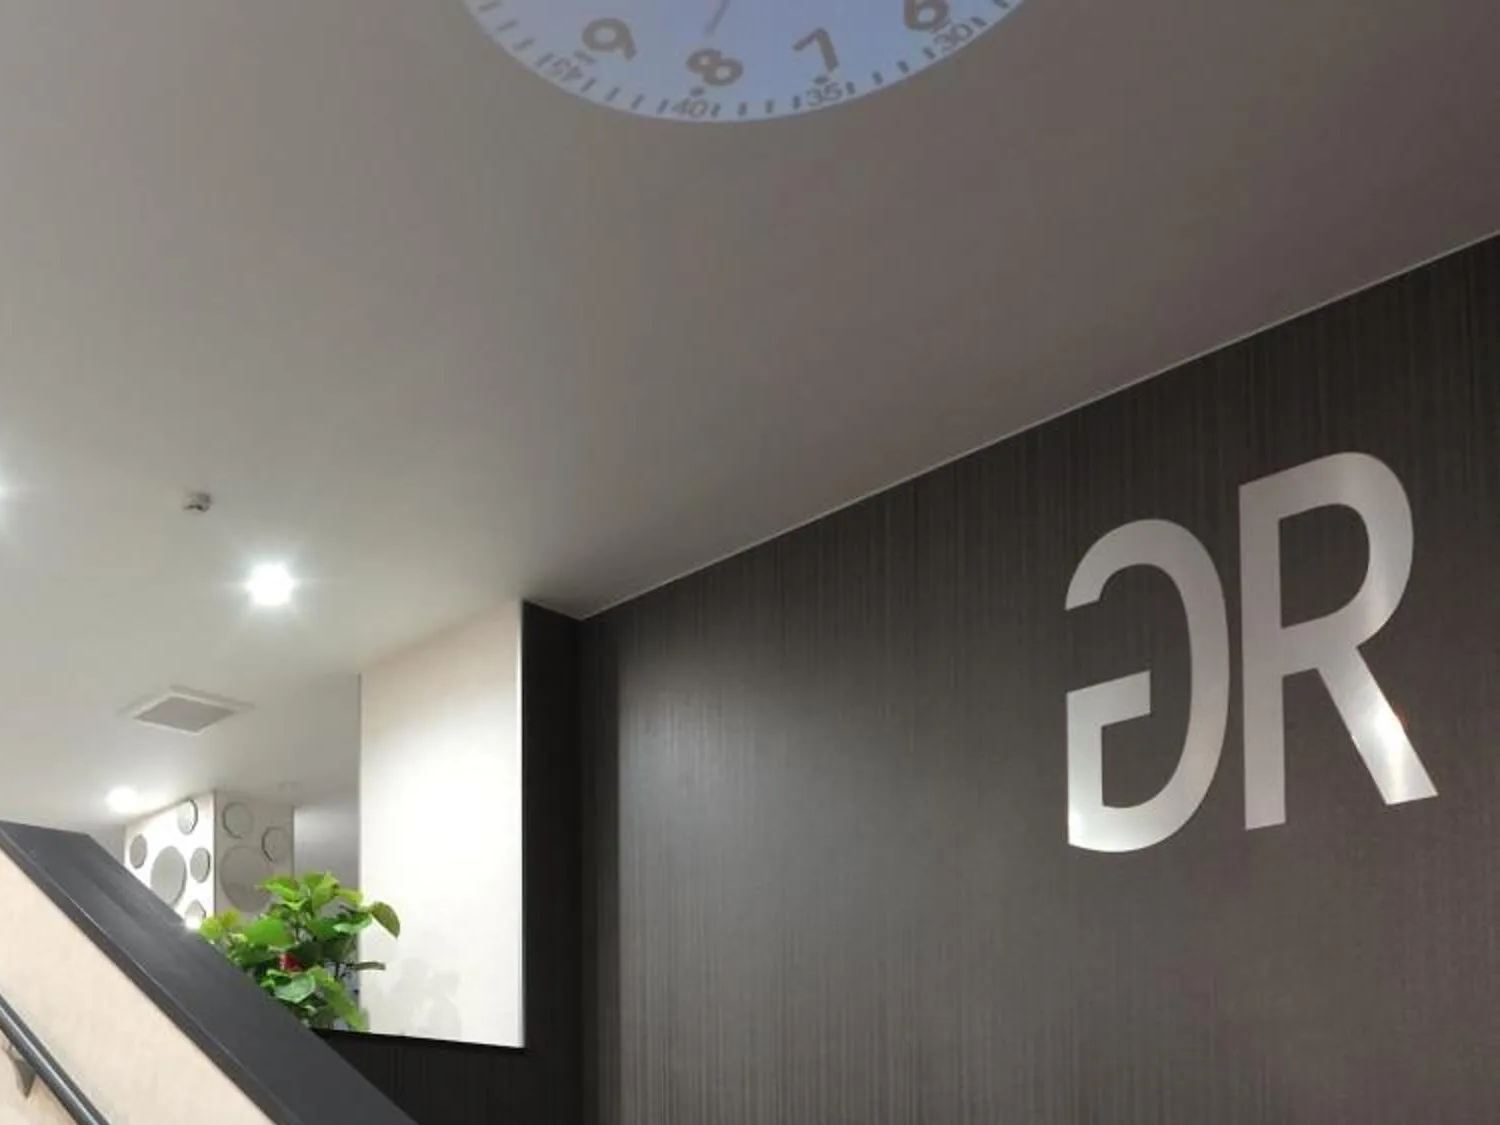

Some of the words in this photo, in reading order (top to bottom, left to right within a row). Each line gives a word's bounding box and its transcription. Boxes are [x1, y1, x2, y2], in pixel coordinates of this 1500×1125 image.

[904, 0, 948, 31] 6
[581, 17, 637, 61] 9
[792, 27, 839, 73] 7
[686, 48, 744, 86] 8
[671, 98, 709, 118] 40
[1065, 452, 1439, 853] GR
